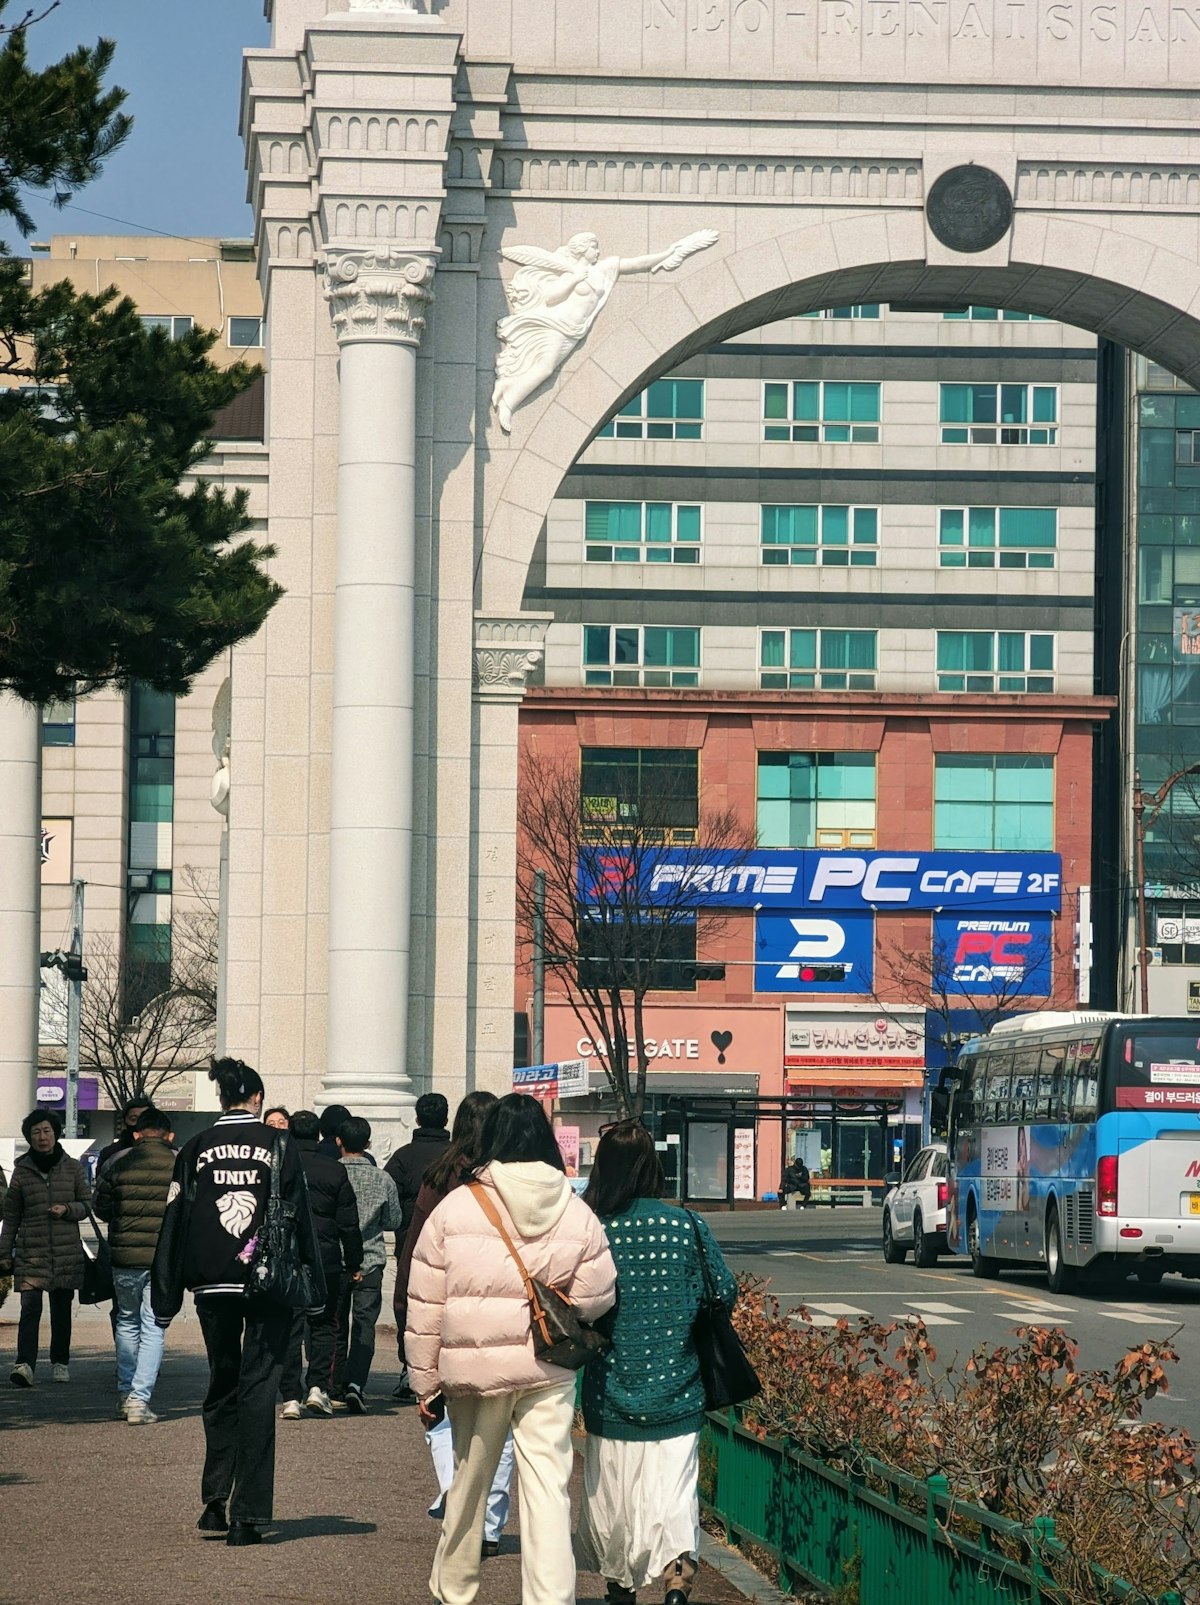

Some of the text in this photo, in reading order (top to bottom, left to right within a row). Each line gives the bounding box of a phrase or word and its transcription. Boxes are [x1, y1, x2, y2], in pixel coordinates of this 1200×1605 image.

[650, 857, 1060, 902] PRIME PC CAFE 2F
[957, 921, 1030, 931] PREMIUM
[954, 932, 1032, 964] PC
[952, 964, 1026, 982] CAFE
[643, 1038, 699, 1058] GATE
[1145, 1091, 1164, 1104] 결이
[213, 1169, 261, 1185] UNIV.
